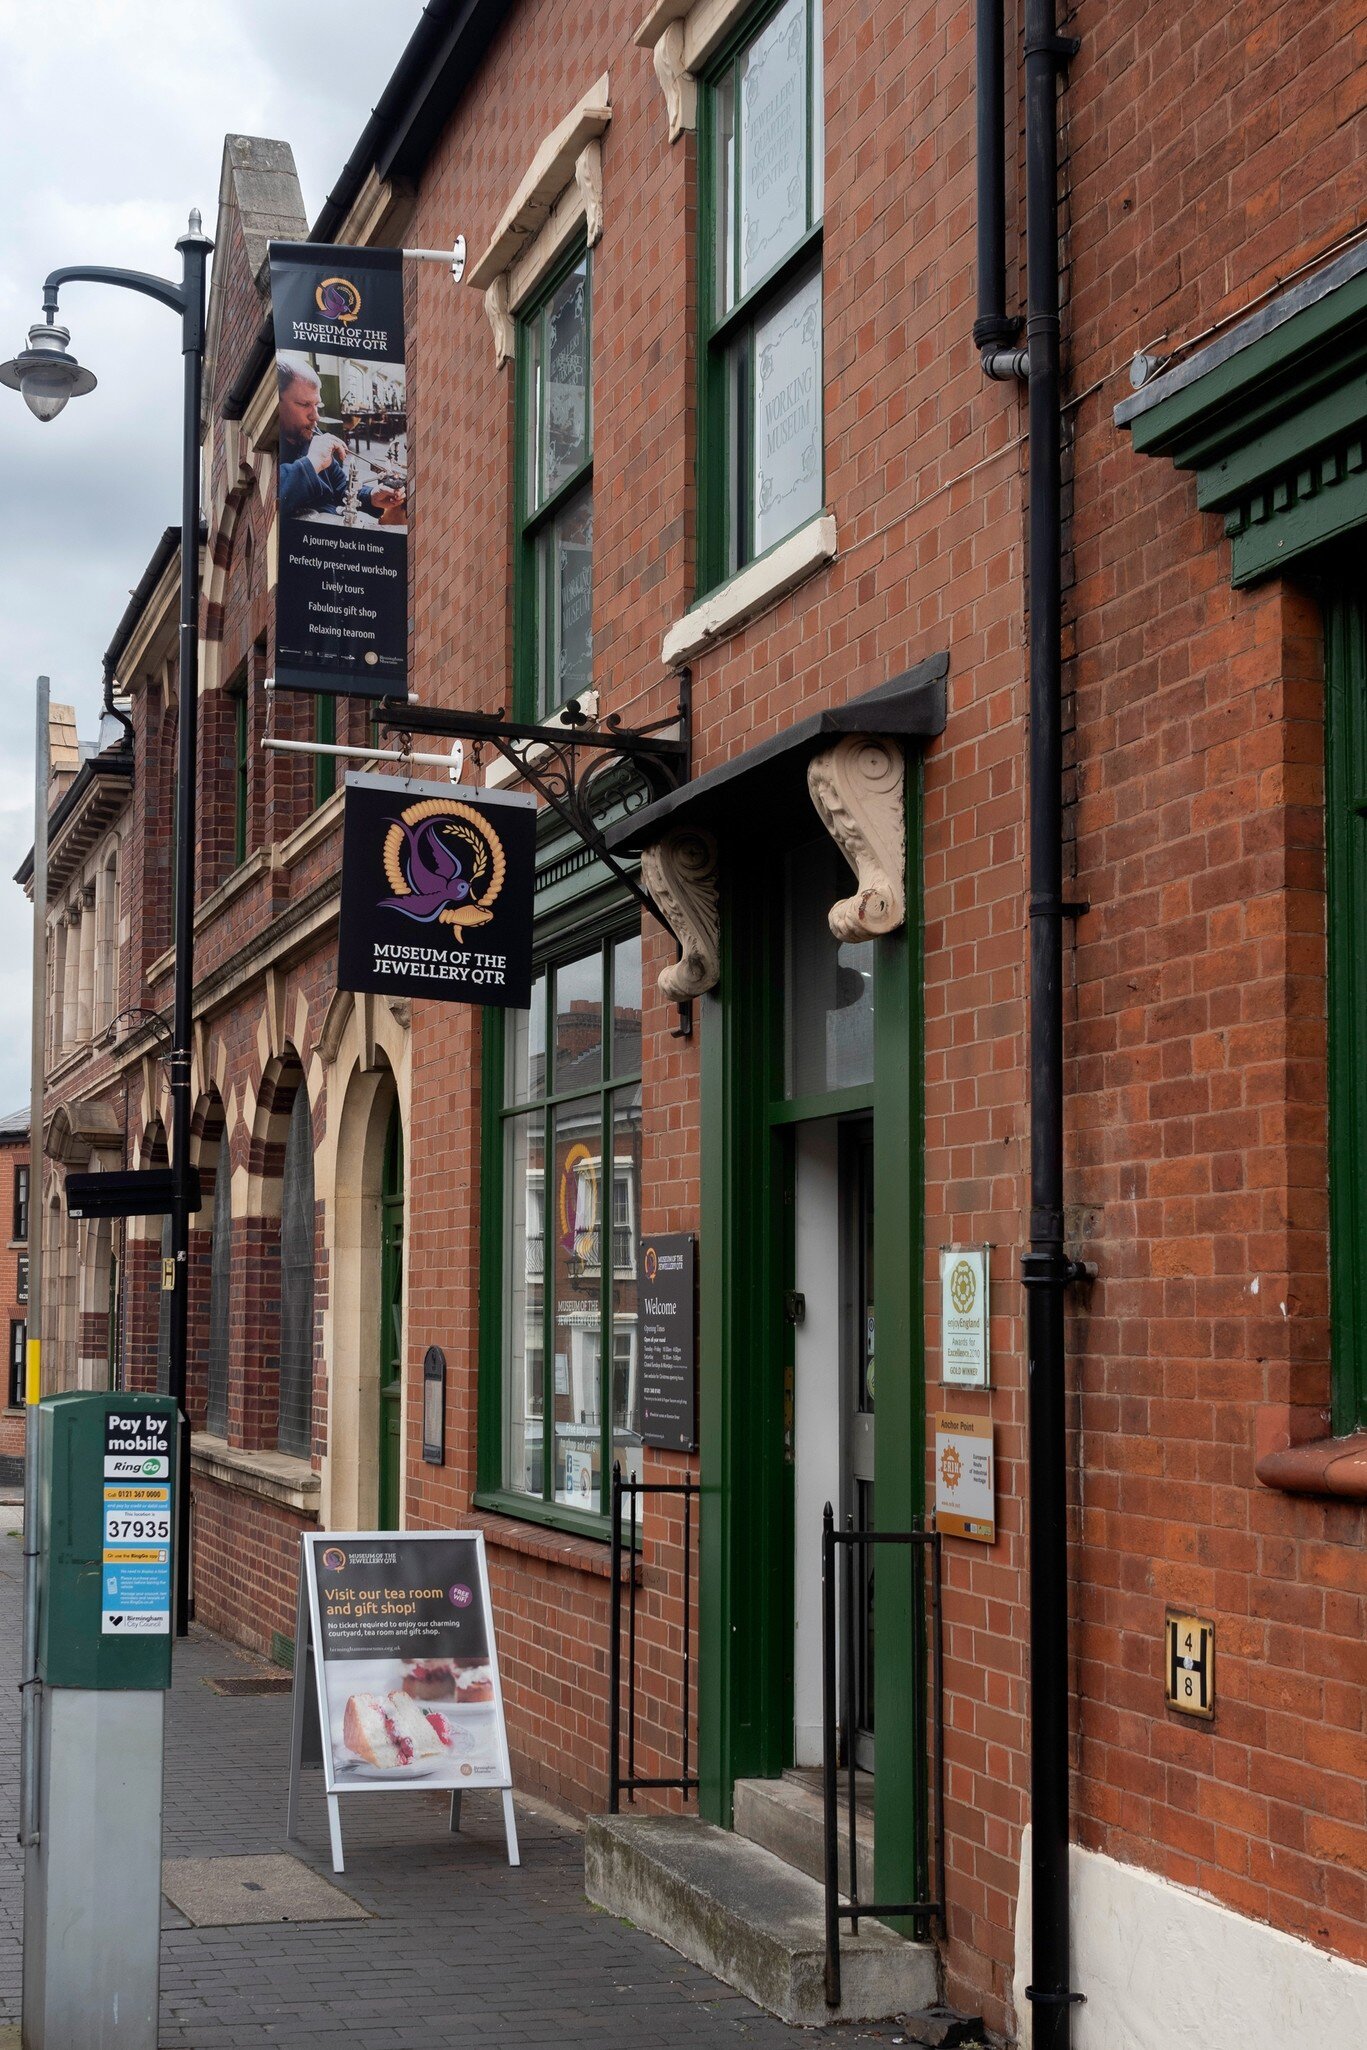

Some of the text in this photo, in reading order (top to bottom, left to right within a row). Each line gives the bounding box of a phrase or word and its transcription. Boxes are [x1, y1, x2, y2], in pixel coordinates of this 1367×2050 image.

[750, 72, 797, 142] JEWELLERY
[754, 104, 792, 158] QUARTER
[751, 121, 796, 185] DISCOVERY
[756, 153, 790, 200] CENTRE
[292, 321, 387, 341] MUSEUM OF THE
[293, 331, 388, 351] JEWELLERY QTR
[765, 367, 813, 427] WORKING
[766, 400, 810, 458] MUSEUM
[302, 534, 385, 554] A journey back in time
[289, 554, 398, 578] Perfectly preserved workshop
[321, 581, 365, 595] Lively tours
[308, 601, 377, 620] Fabulous gift shop
[308, 623, 376, 639] Relaxing tearoom
[373, 943, 506, 969] MUSEUM OF THE
[373, 959, 506, 985] JEWELLERY QTR
[557, 1299, 599, 1312] MUSEUM OF THE
[644, 1297, 677, 1315] Welcome
[949, 1366, 961, 1375] GOLD
[109, 1415, 168, 1434] Pay by
[940, 1420, 974, 1432] Anchor Point
[109, 1435, 168, 1451] mobile
[113, 1461, 160, 1473] RingGo
[118, 1490, 132, 1498] 0121
[134, 1490, 145, 1498] 367
[146, 1490, 161, 1498] 0000
[108, 1521, 169, 1538] 37935
[325, 1588, 470, 1601] Visit our tea room FREE
[326, 1601, 416, 1617] and gift shop!
[127, 1615, 164, 1623] Birmingham
[359, 1621, 388, 1630] required
[398, 1621, 416, 1631] enjoy
[429, 1620, 460, 1629] charming
[328, 1629, 363, 1638] courtyard,
[409, 1628, 422, 1637] gift
[422, 1628, 440, 1637] shop.
[1184, 1632, 1193, 1652] 4
[1184, 1677, 1193, 1697] 8
